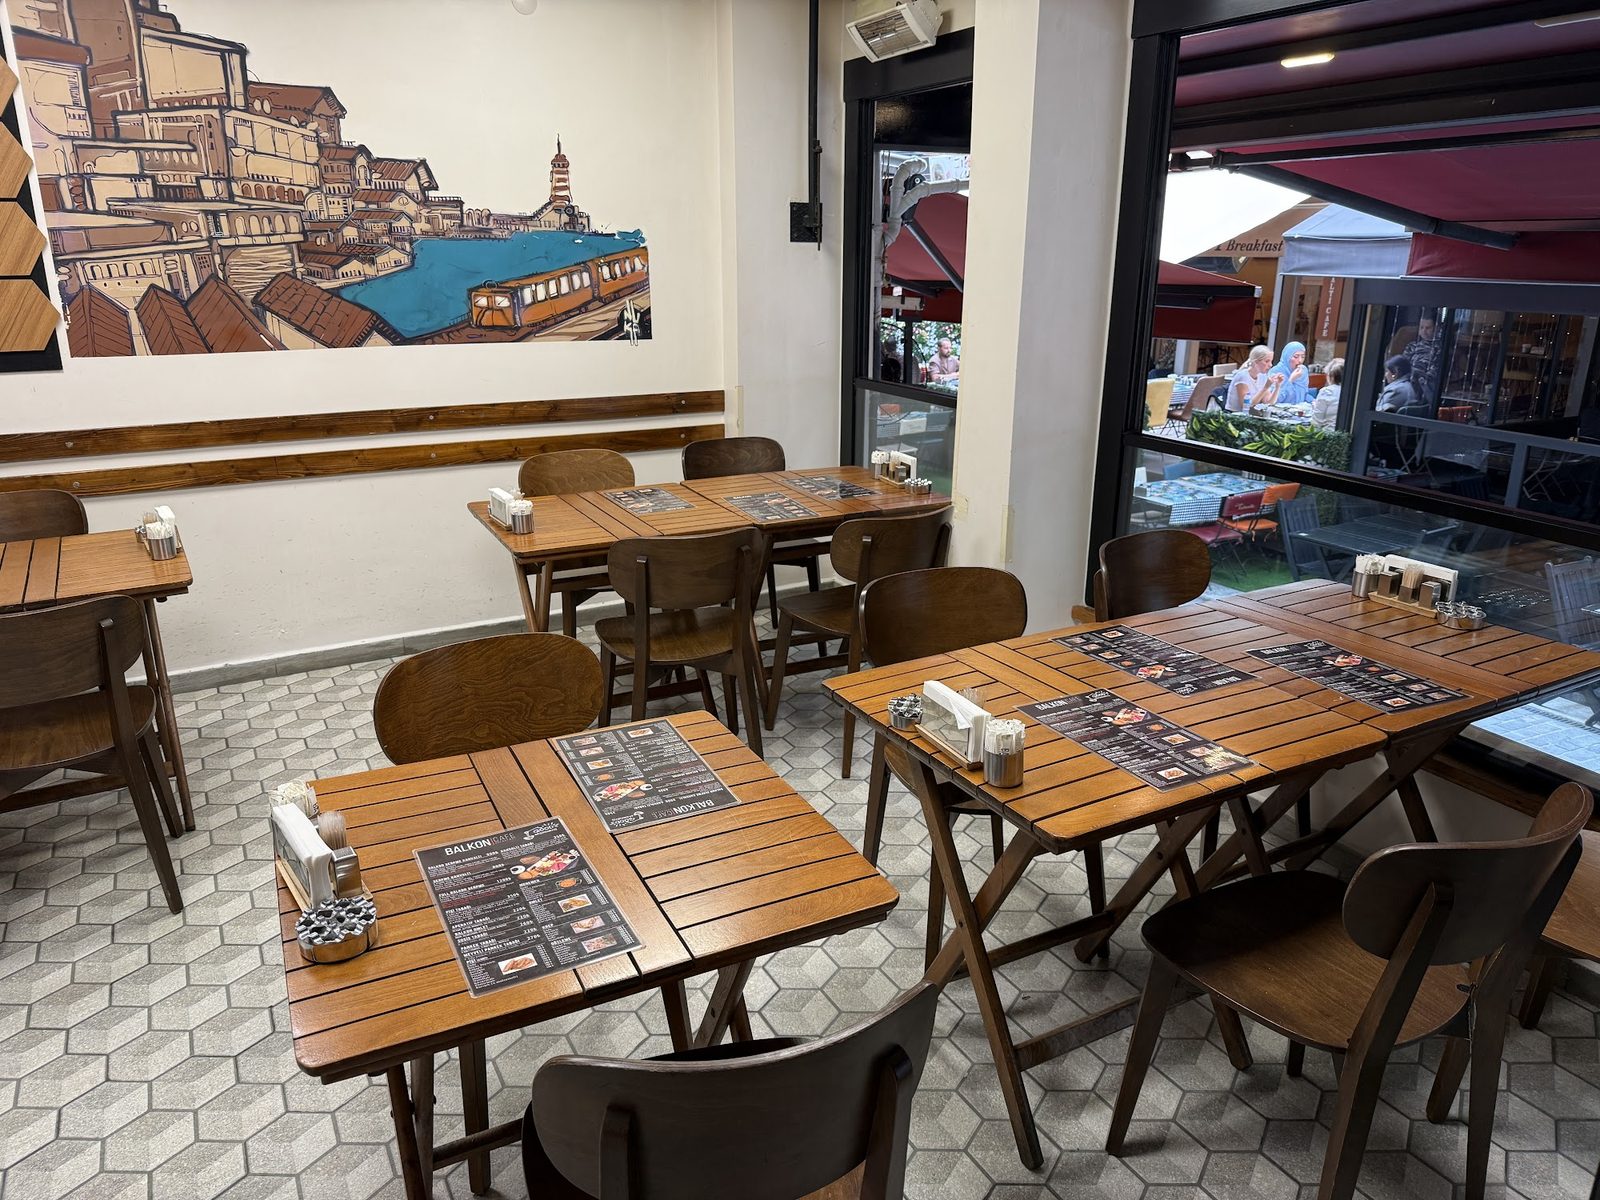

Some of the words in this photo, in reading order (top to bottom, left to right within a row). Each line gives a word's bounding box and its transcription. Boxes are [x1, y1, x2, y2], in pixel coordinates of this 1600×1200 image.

[1226, 239, 1284, 252] Breakfast
[1321, 307, 1332, 336] CAFE
[673, 799, 715, 813] BALKON
[444, 839, 492, 856] BALKON
